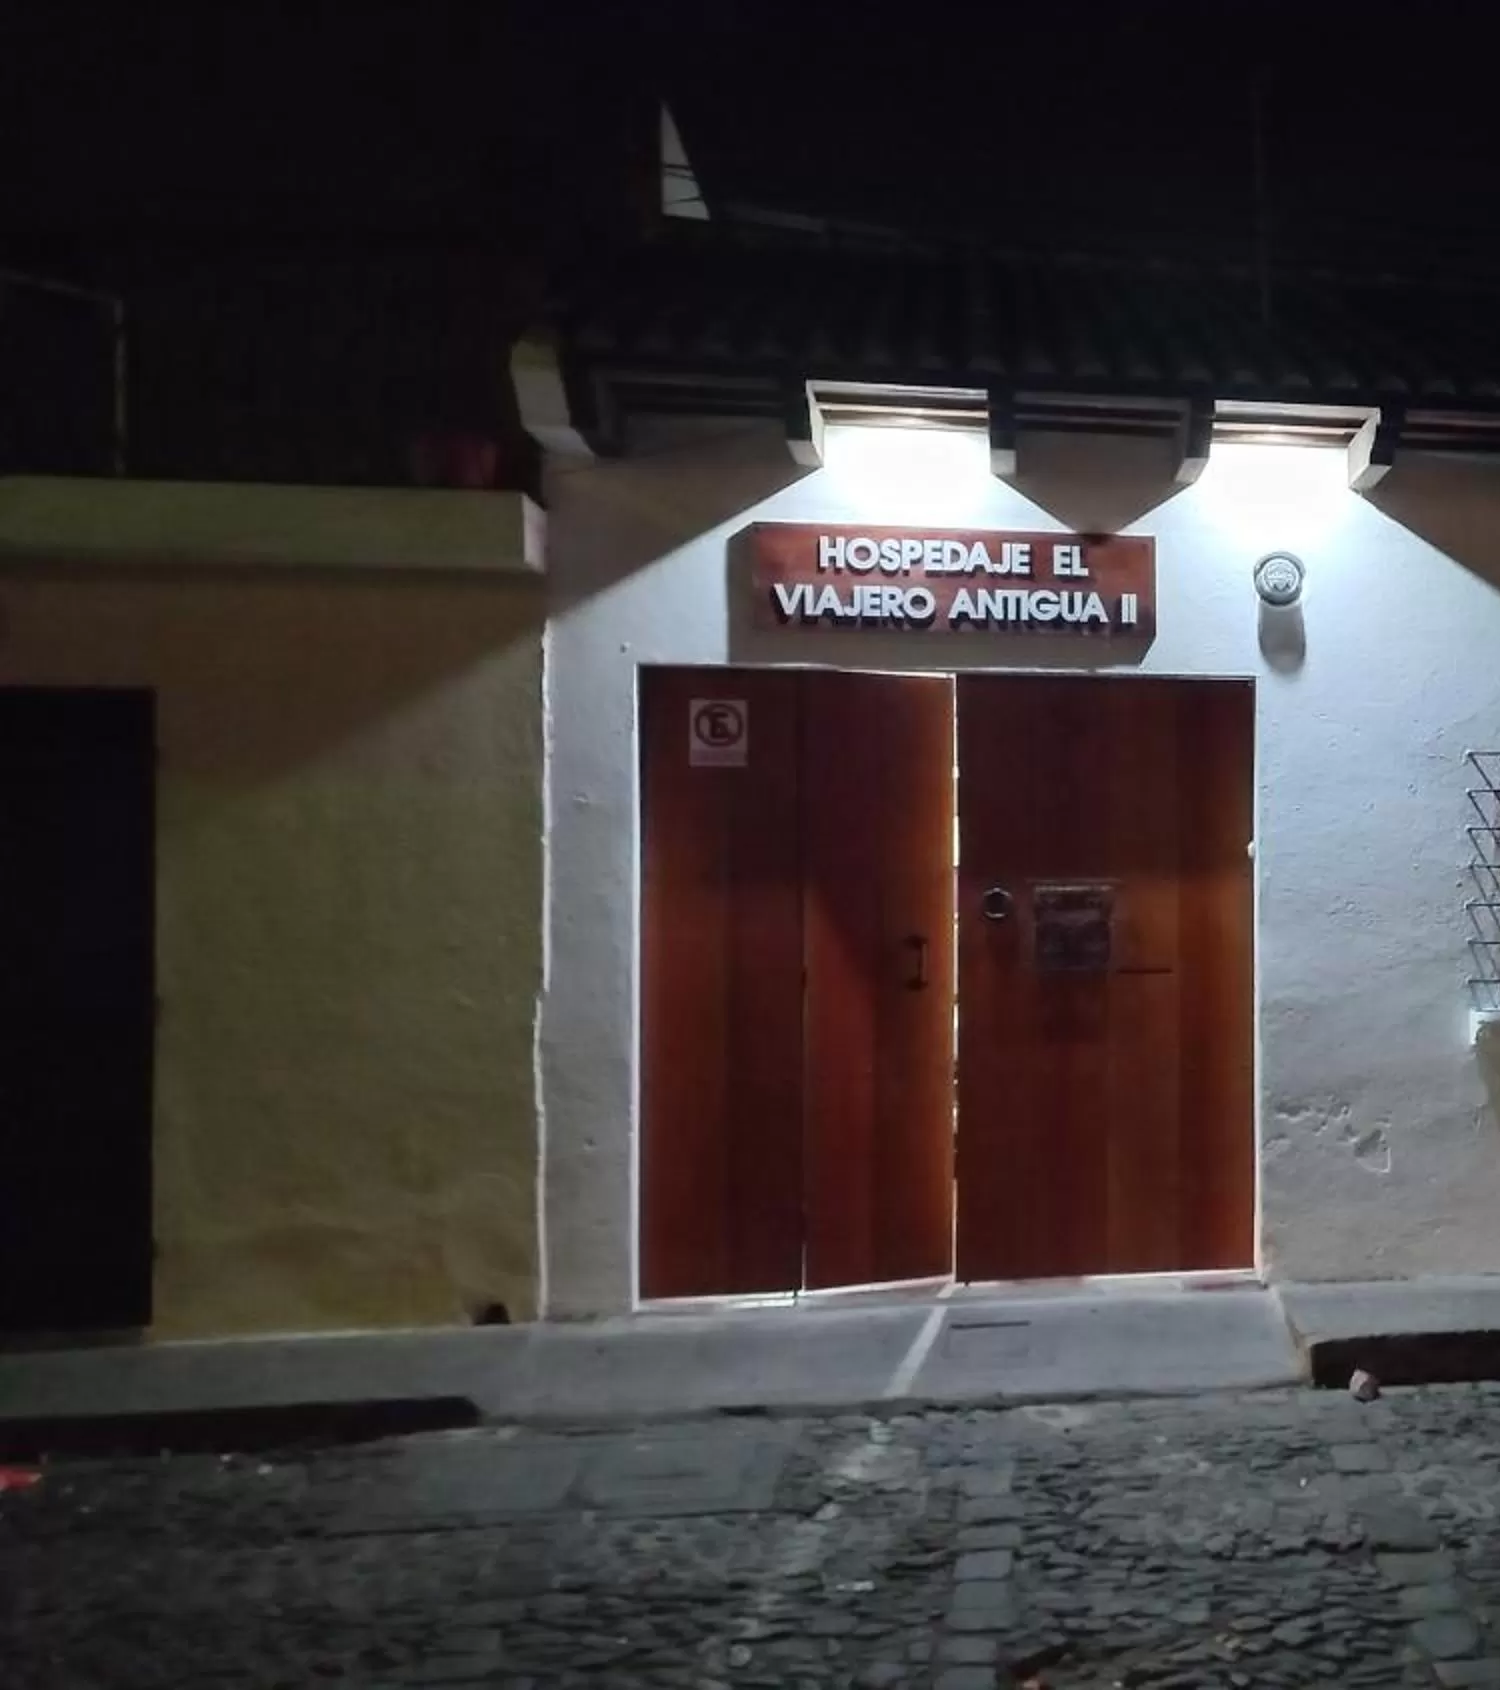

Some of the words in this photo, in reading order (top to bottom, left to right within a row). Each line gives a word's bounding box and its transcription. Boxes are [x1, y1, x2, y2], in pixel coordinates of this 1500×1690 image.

[819, 535, 1030, 576] HOSPEDAJE
[1053, 544, 1089, 577] EL
[774, 583, 936, 620] VIAJERO
[949, 588, 1109, 624] ANTIGUA
[1121, 593, 1138, 625] II
